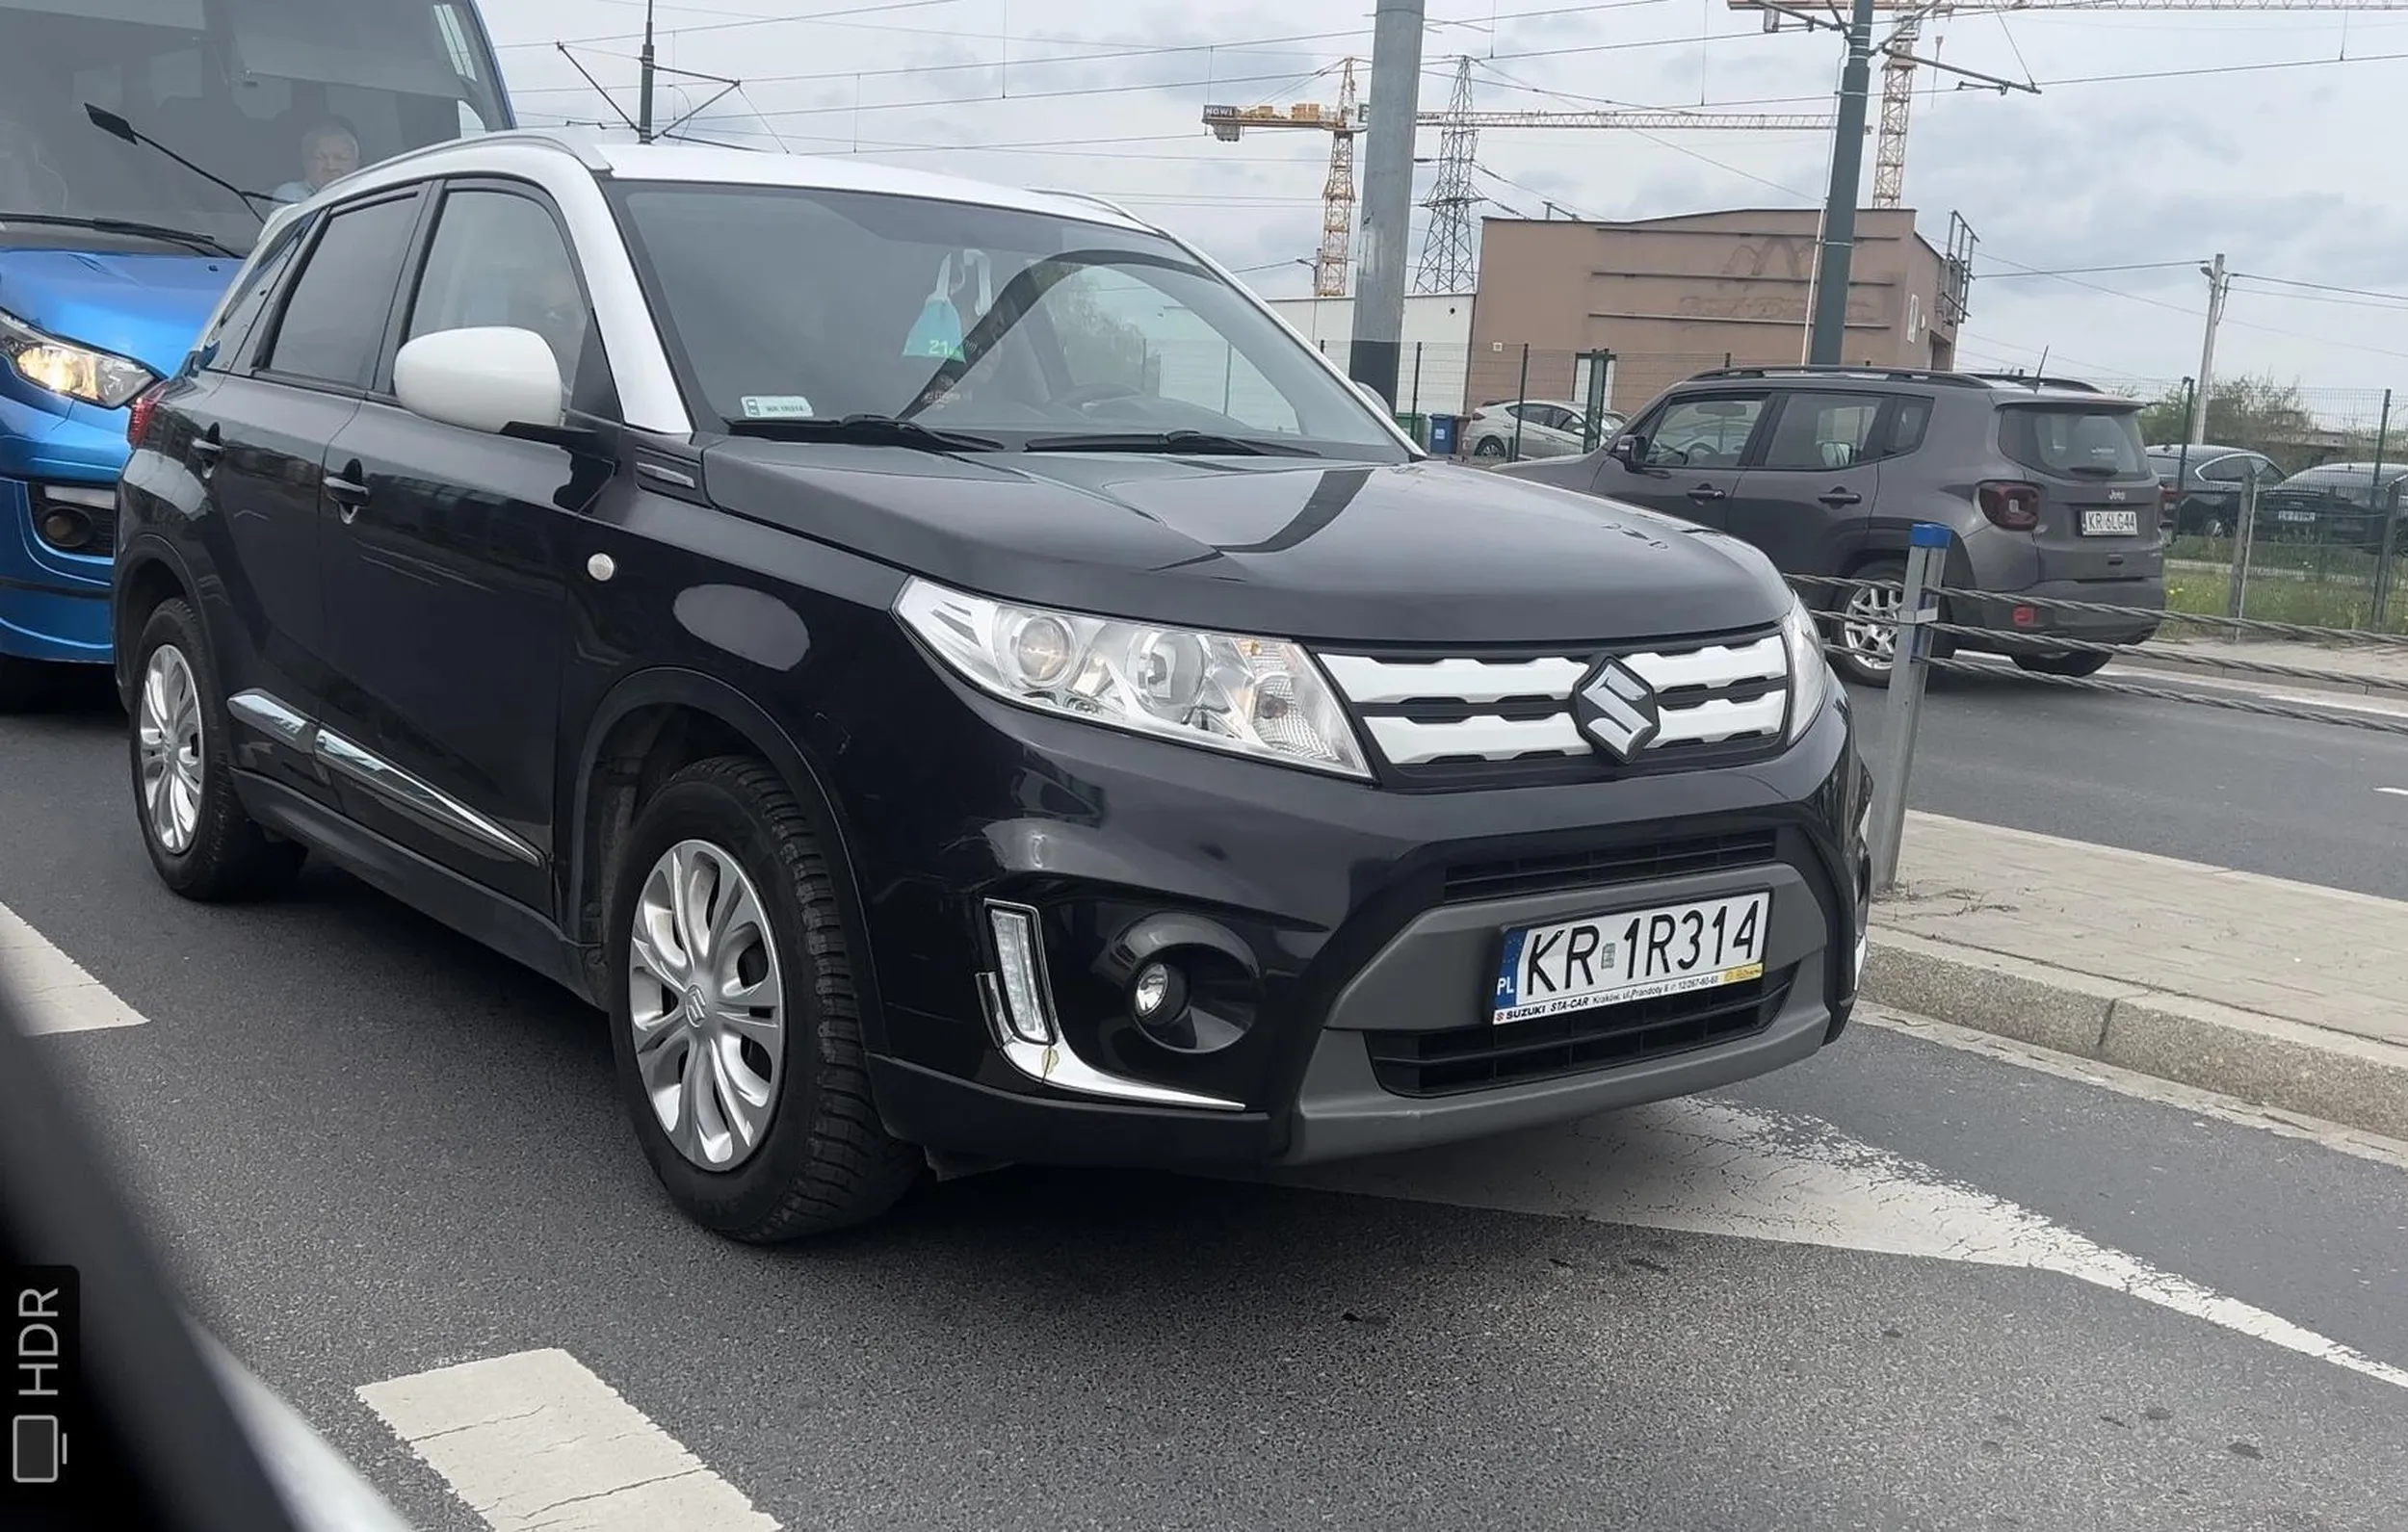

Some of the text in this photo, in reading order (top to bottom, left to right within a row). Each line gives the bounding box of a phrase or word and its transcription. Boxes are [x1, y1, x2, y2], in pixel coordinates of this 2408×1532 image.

[2088, 512, 2103, 530] KR
[1527, 899, 1760, 996] KR 1R314
[1496, 976, 1515, 997] PL
[1505, 1004, 1546, 1020] SUZUKI
[1550, 997, 1589, 1013] STA-CAR
